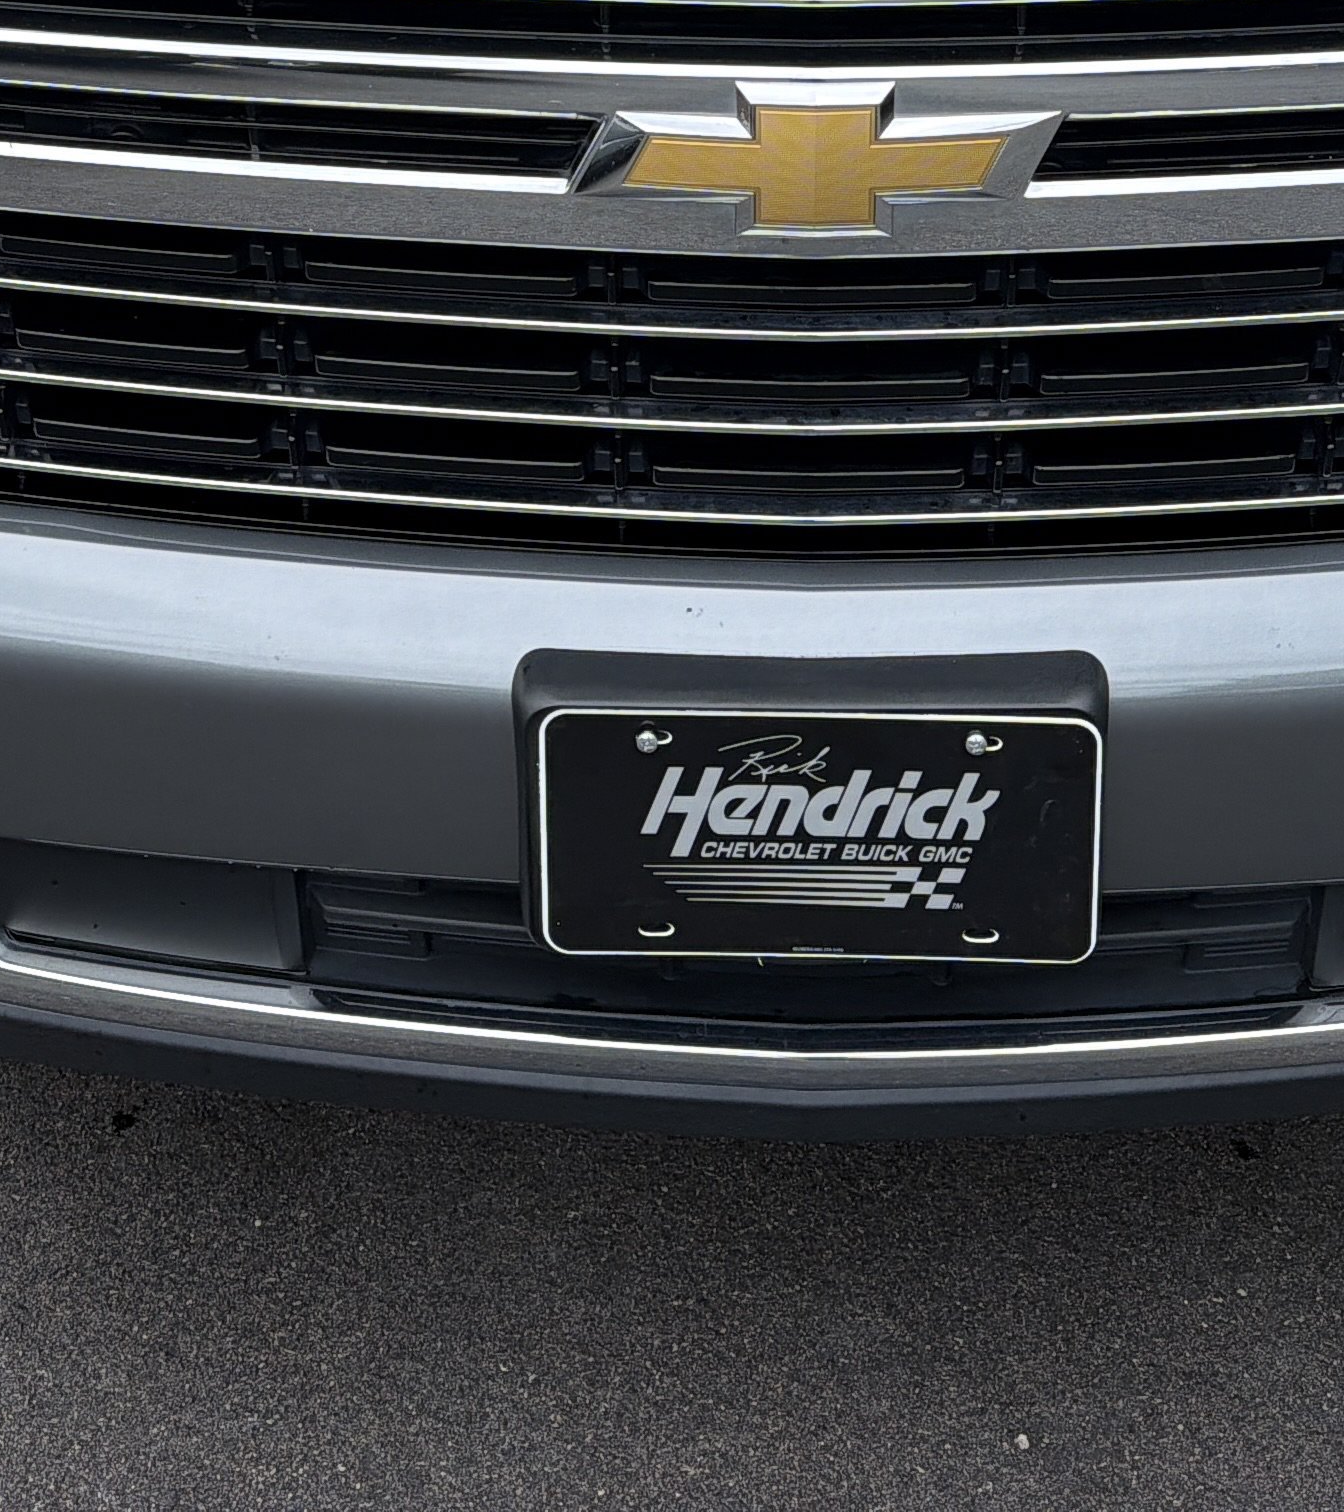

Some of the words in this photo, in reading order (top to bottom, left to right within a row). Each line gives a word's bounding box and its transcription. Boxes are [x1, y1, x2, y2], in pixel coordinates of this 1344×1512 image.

[640, 766, 1001, 857] Hendrick
[701, 841, 837, 860] CHEVROLET
[841, 843, 913, 862] BUICK
[918, 846, 973, 864] GMC
